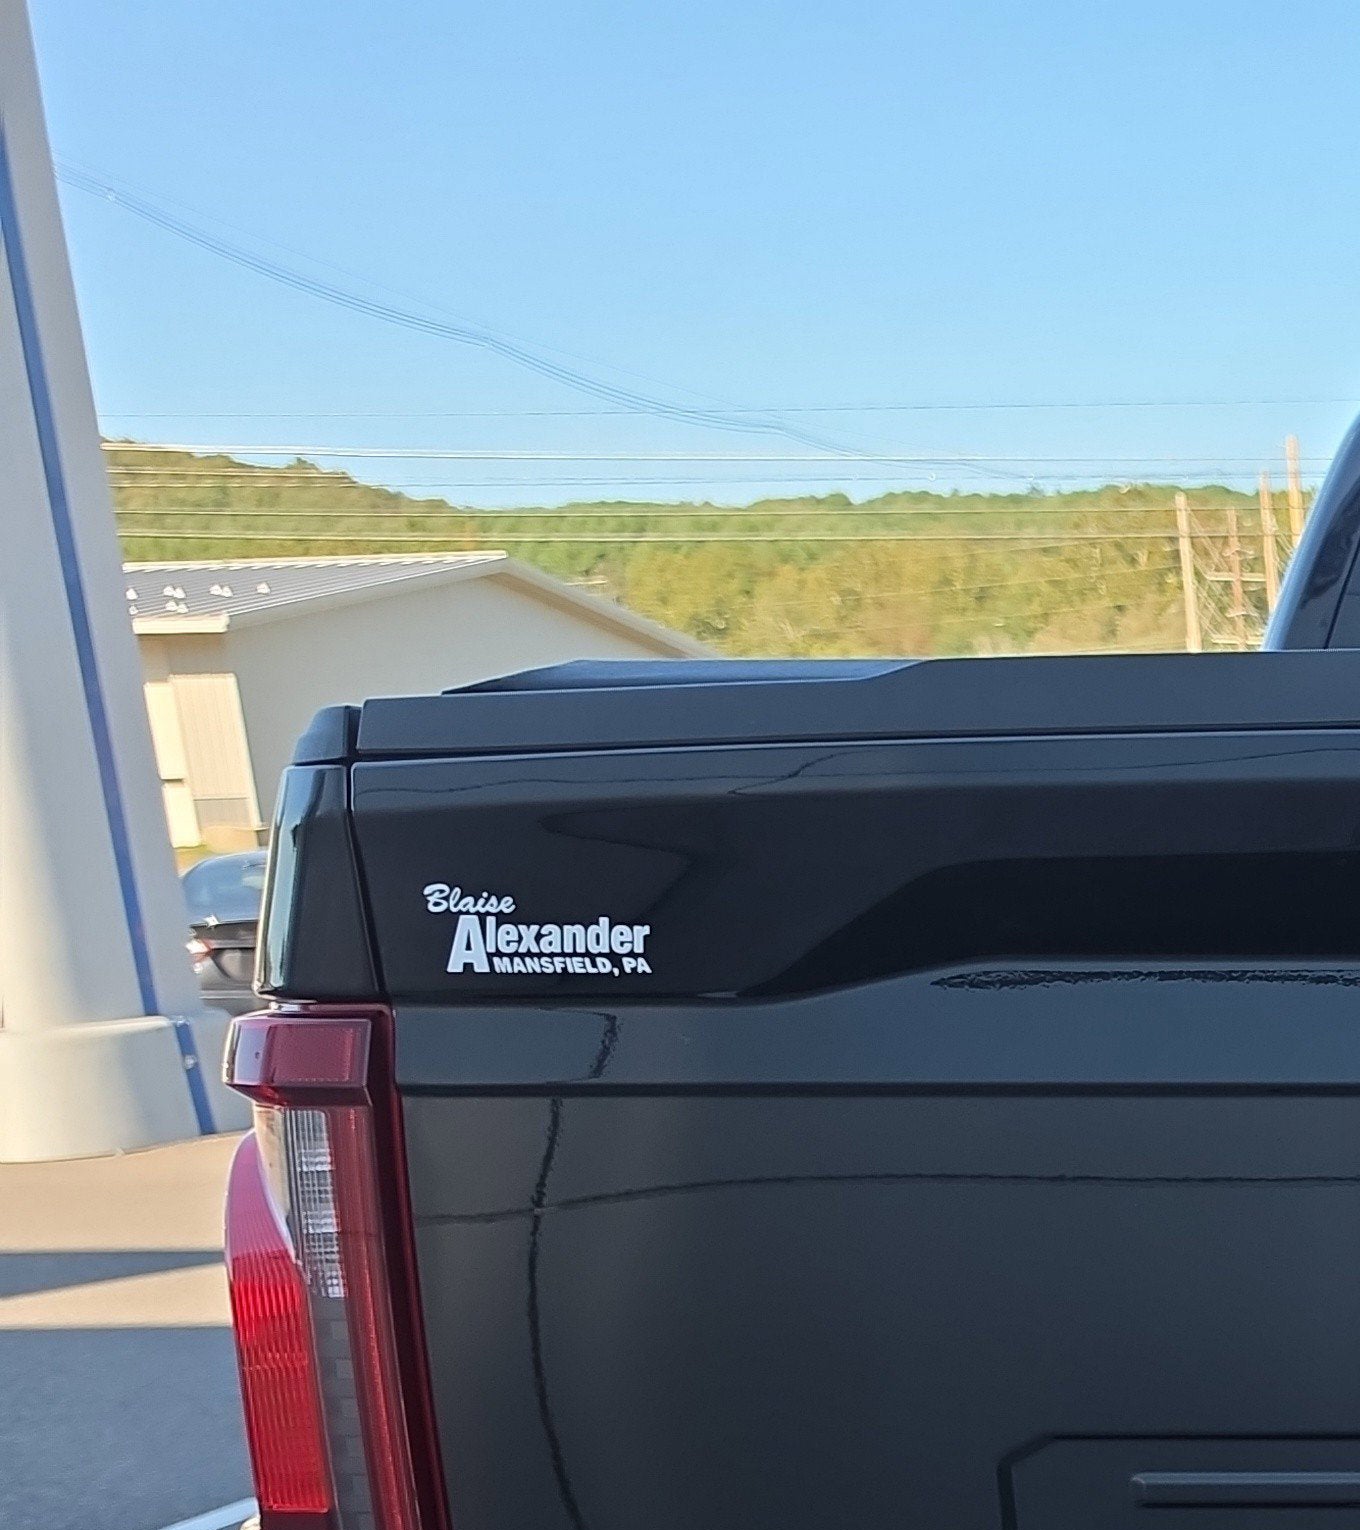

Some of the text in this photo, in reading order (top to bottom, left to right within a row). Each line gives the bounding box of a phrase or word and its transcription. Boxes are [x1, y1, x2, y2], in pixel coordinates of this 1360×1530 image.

[423, 883, 516, 914] Blaise
[447, 914, 651, 973] Alexander
[494, 957, 652, 977] MANSFIELD, PA
